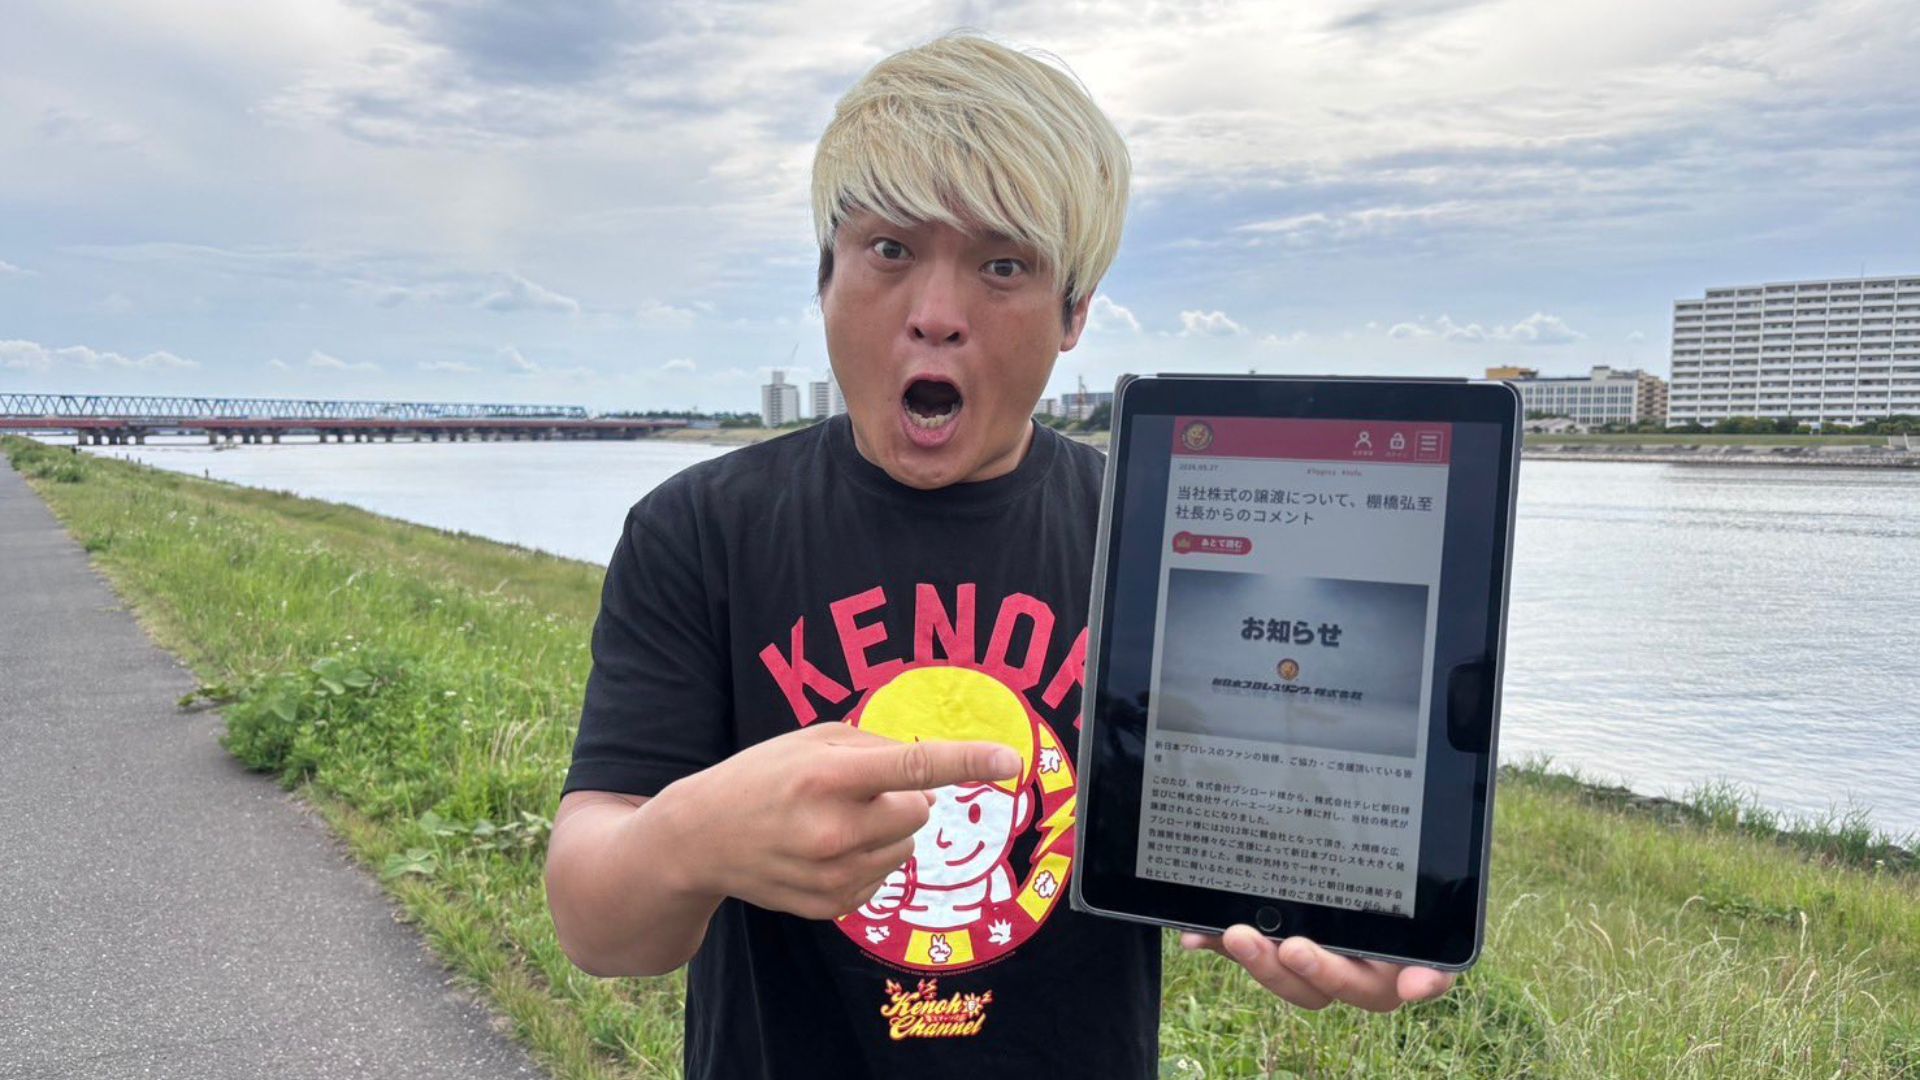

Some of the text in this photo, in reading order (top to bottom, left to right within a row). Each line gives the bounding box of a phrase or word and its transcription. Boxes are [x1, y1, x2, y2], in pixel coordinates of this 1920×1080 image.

[1177, 486, 1433, 512] 当社株式の譲渡について、棚橋弘至
[1175, 504, 1315, 526] 社長からのコメント
[1240, 617, 1342, 648] お知らせ
[880, 991, 963, 1017] Kenoh
[889, 1013, 987, 1041] Channel
